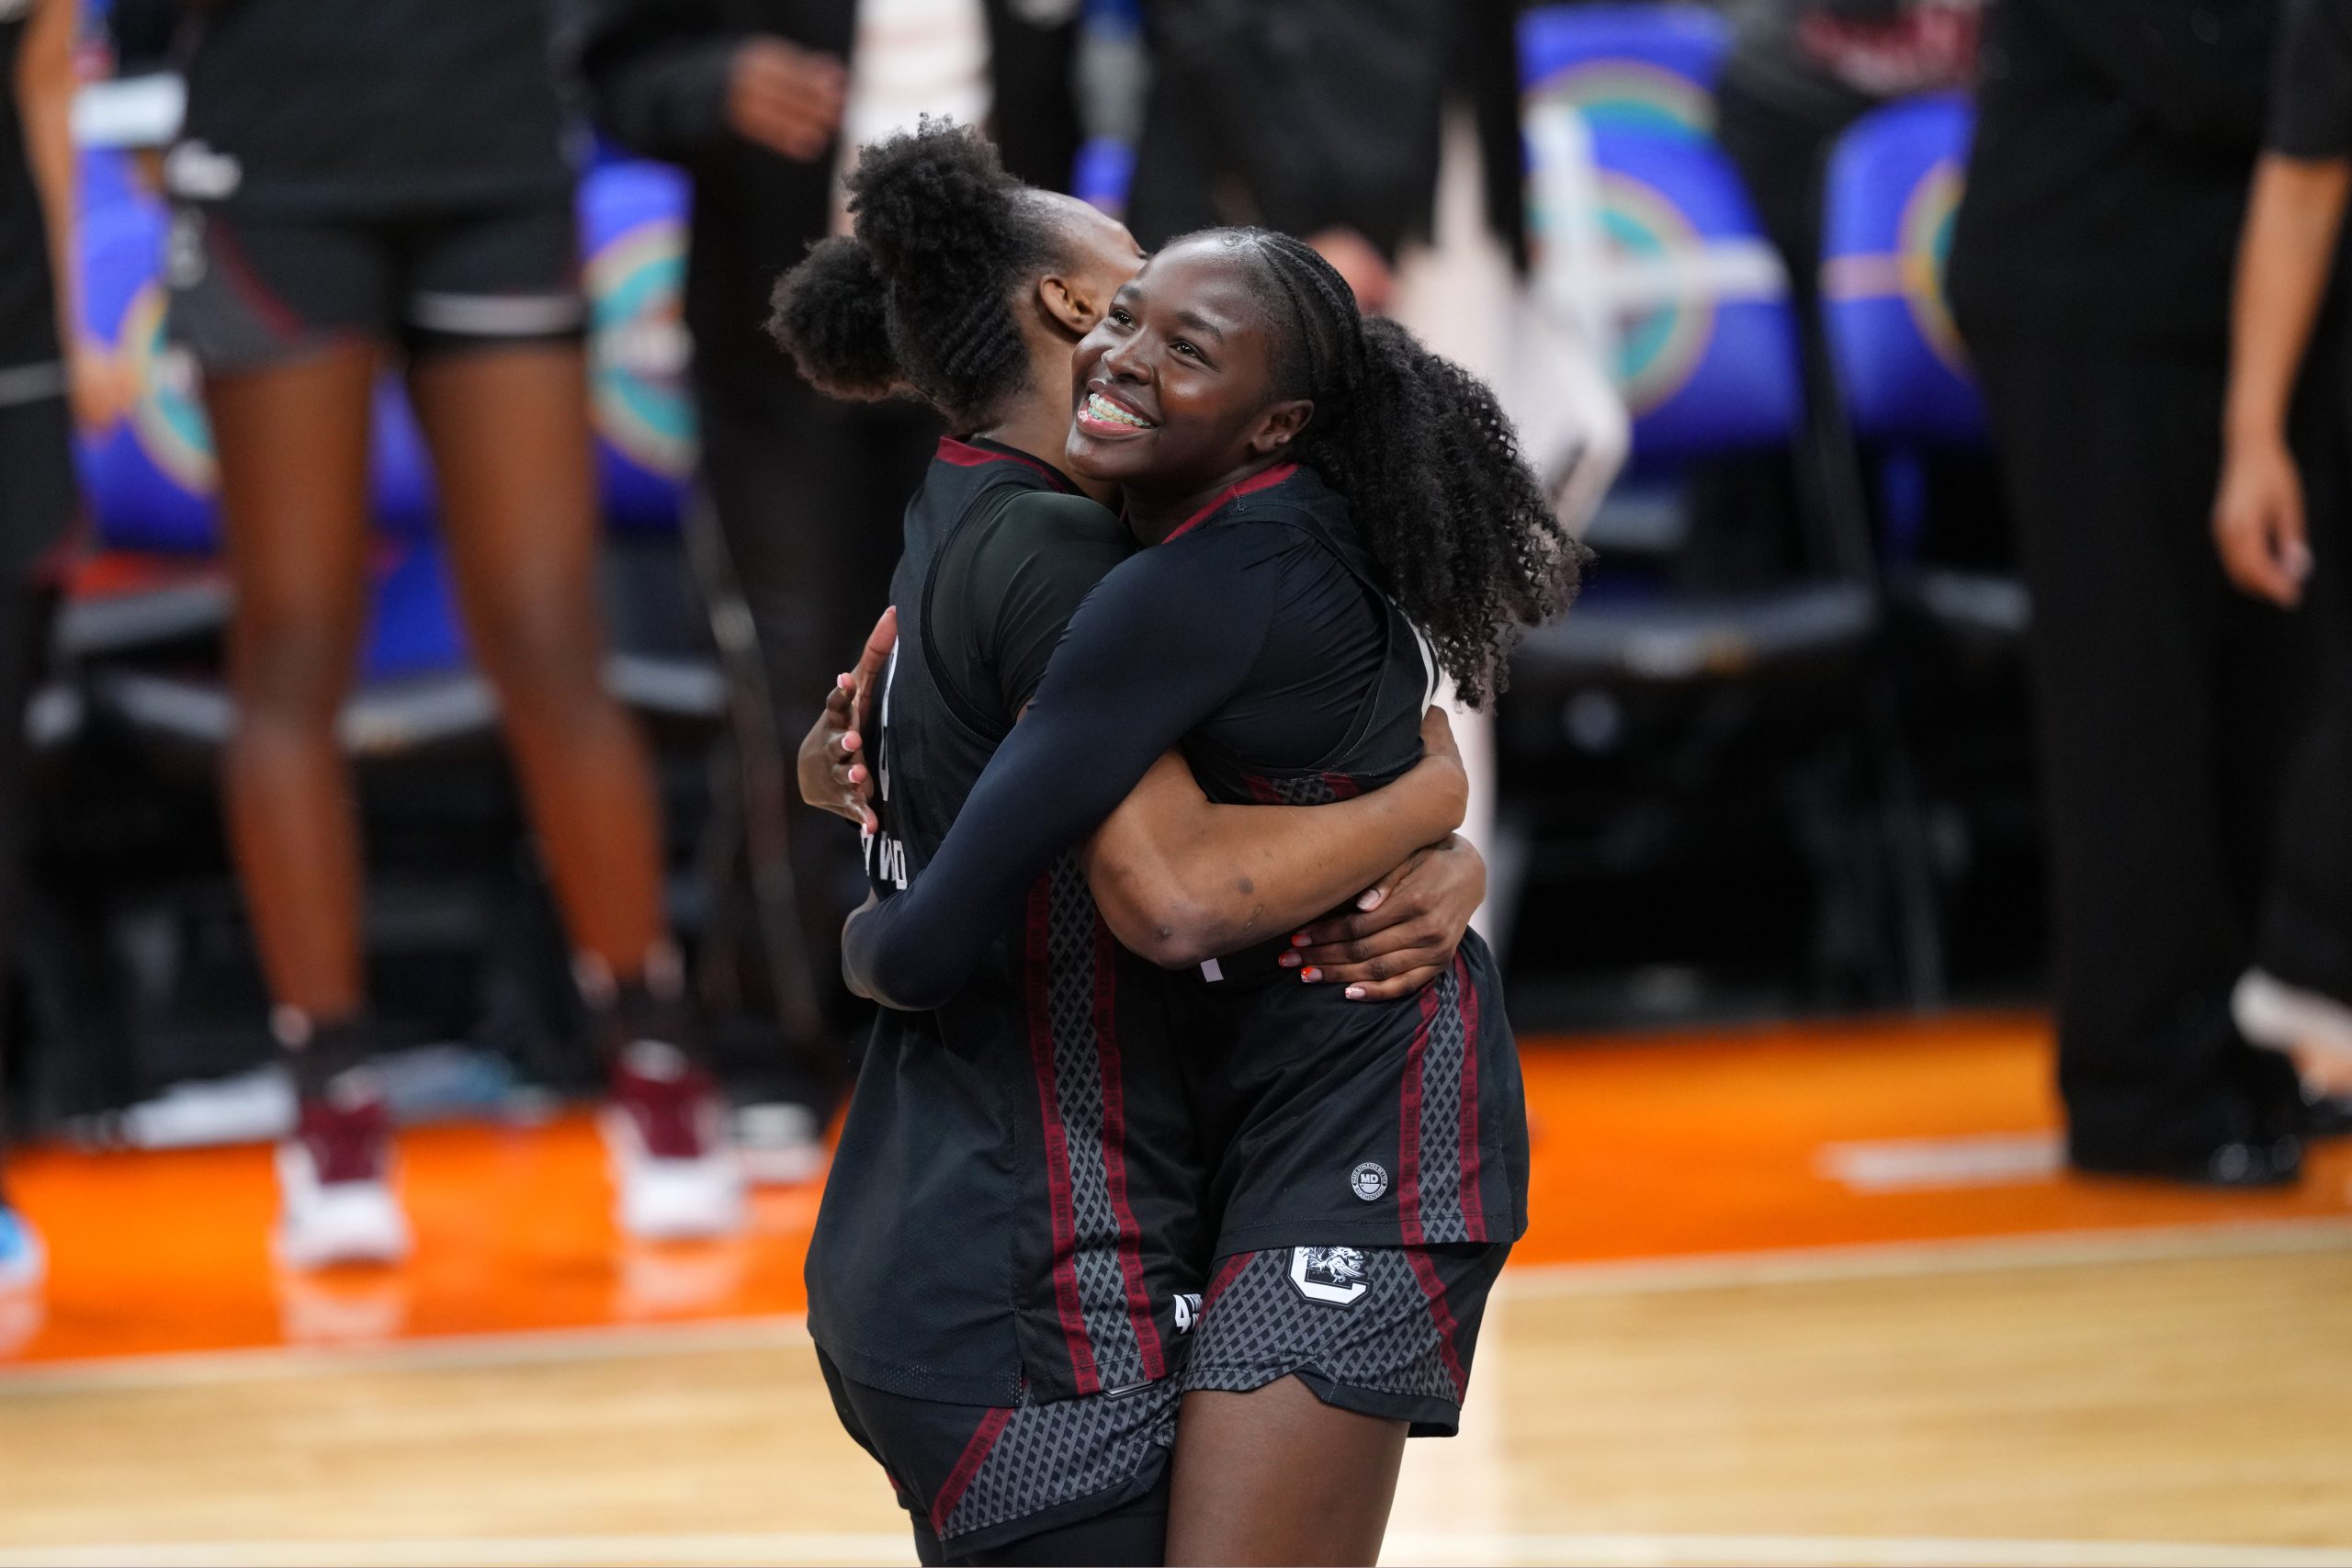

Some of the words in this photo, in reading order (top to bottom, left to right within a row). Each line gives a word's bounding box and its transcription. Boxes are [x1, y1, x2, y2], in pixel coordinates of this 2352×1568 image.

[1361, 1174, 1378, 1183] MD
[1354, 1188, 1385, 1200] AUTHENTIC
[1173, 1294, 1192, 1335] 4
